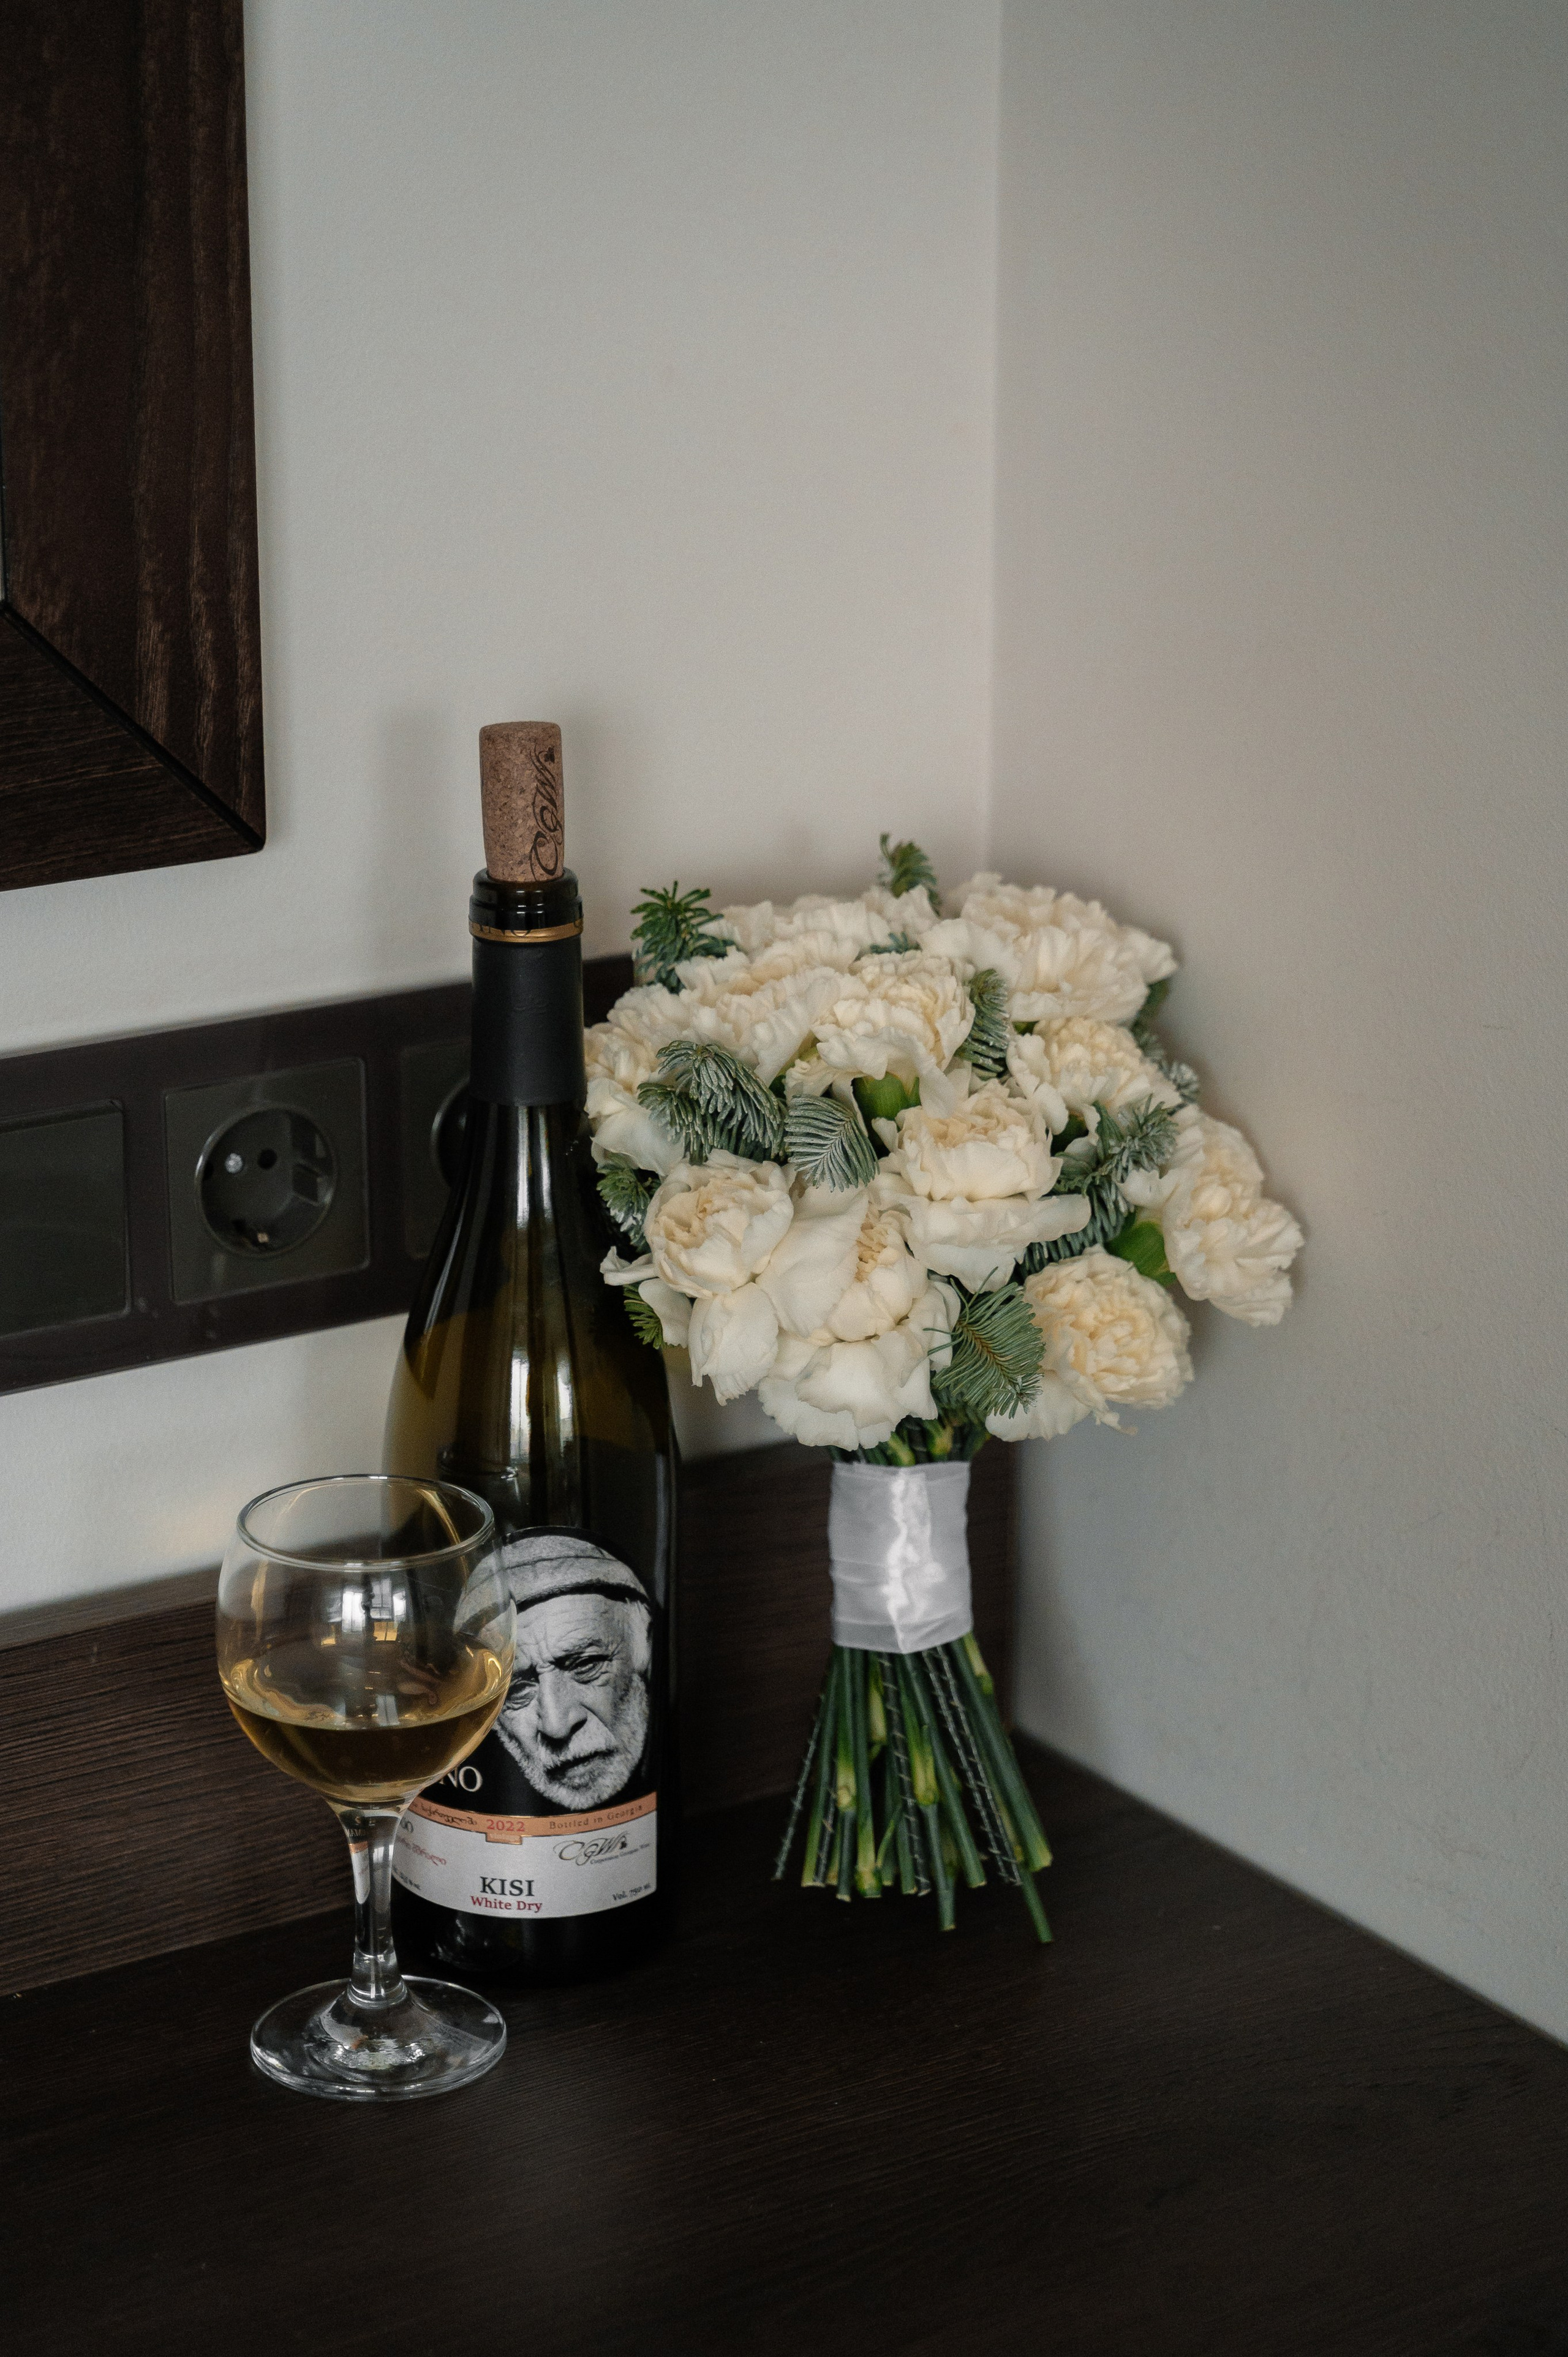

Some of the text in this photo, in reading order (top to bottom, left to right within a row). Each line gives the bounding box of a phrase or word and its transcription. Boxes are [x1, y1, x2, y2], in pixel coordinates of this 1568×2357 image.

[486, 1819, 526, 1832] 2022
[549, 1817, 589, 1830] Bottled
[607, 1805, 643, 1820] Georgia
[480, 1876, 535, 1897] KISI
[470, 1896, 543, 1913] White Dry
